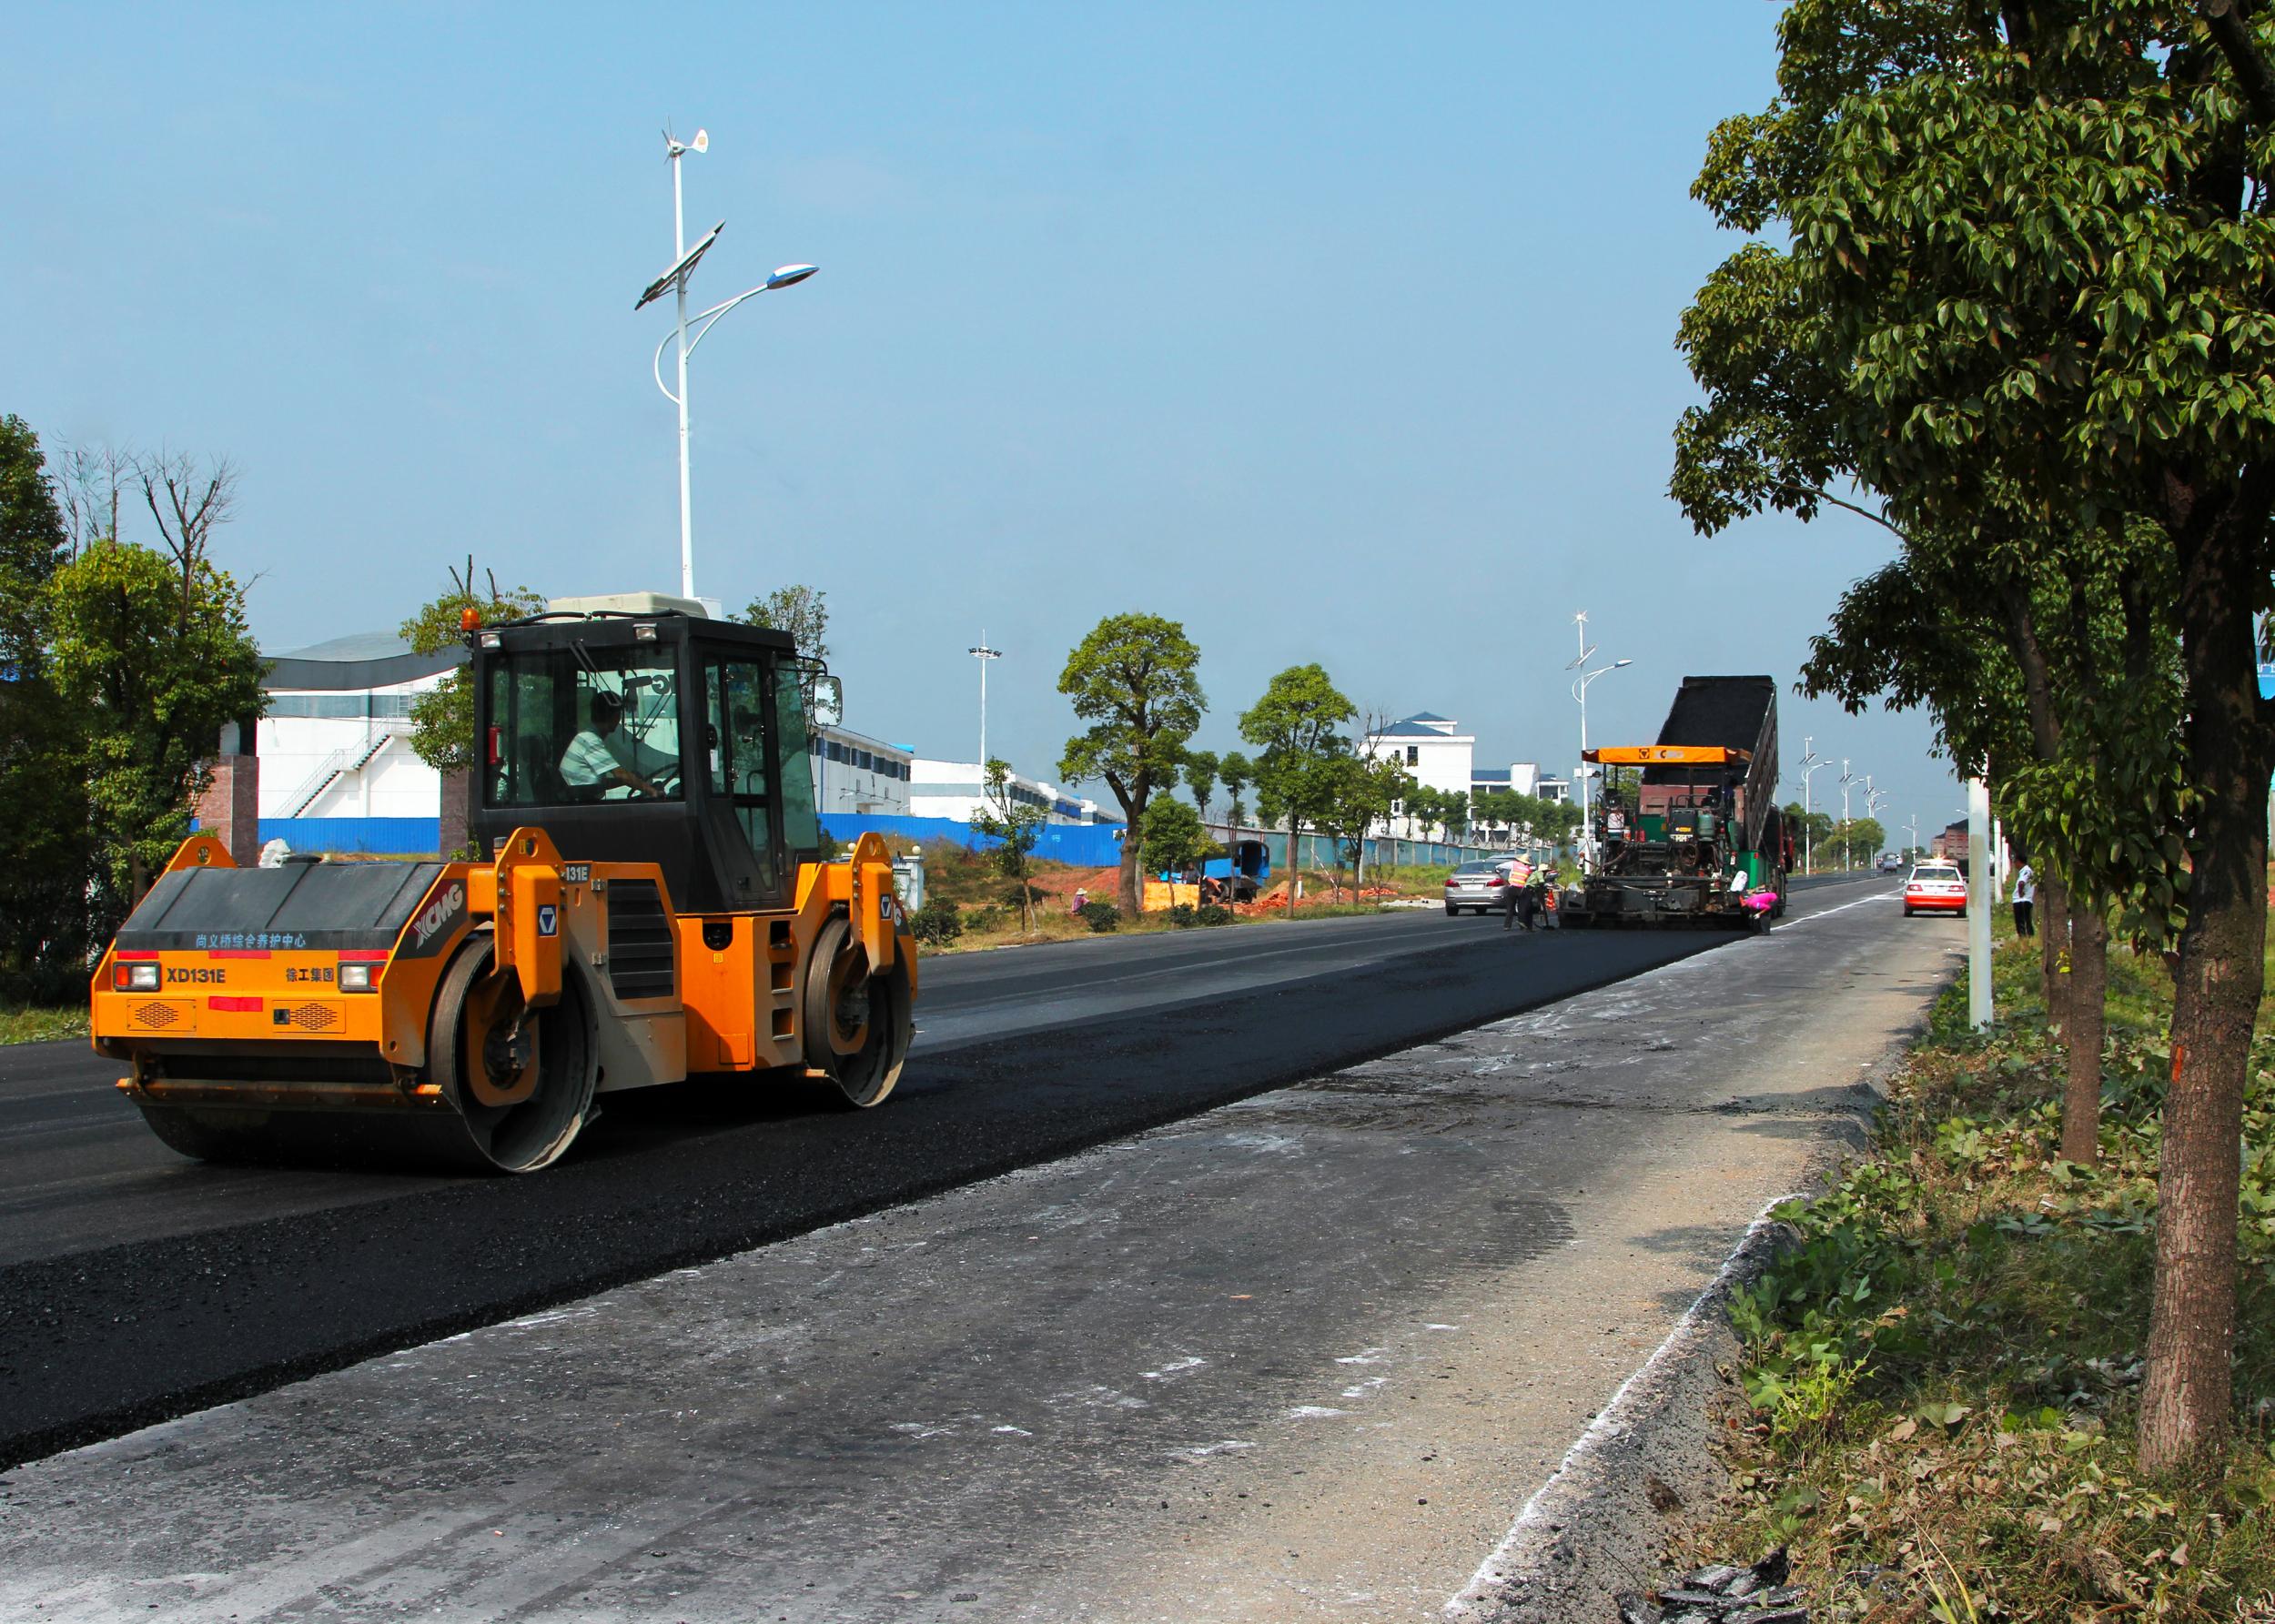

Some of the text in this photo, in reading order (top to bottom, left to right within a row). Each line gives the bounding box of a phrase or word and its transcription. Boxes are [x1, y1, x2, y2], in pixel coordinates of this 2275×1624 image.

[414, 884, 462, 948] XCMG
[167, 968, 226, 983] XD131E
[286, 967, 334, 983] 徐工集团
